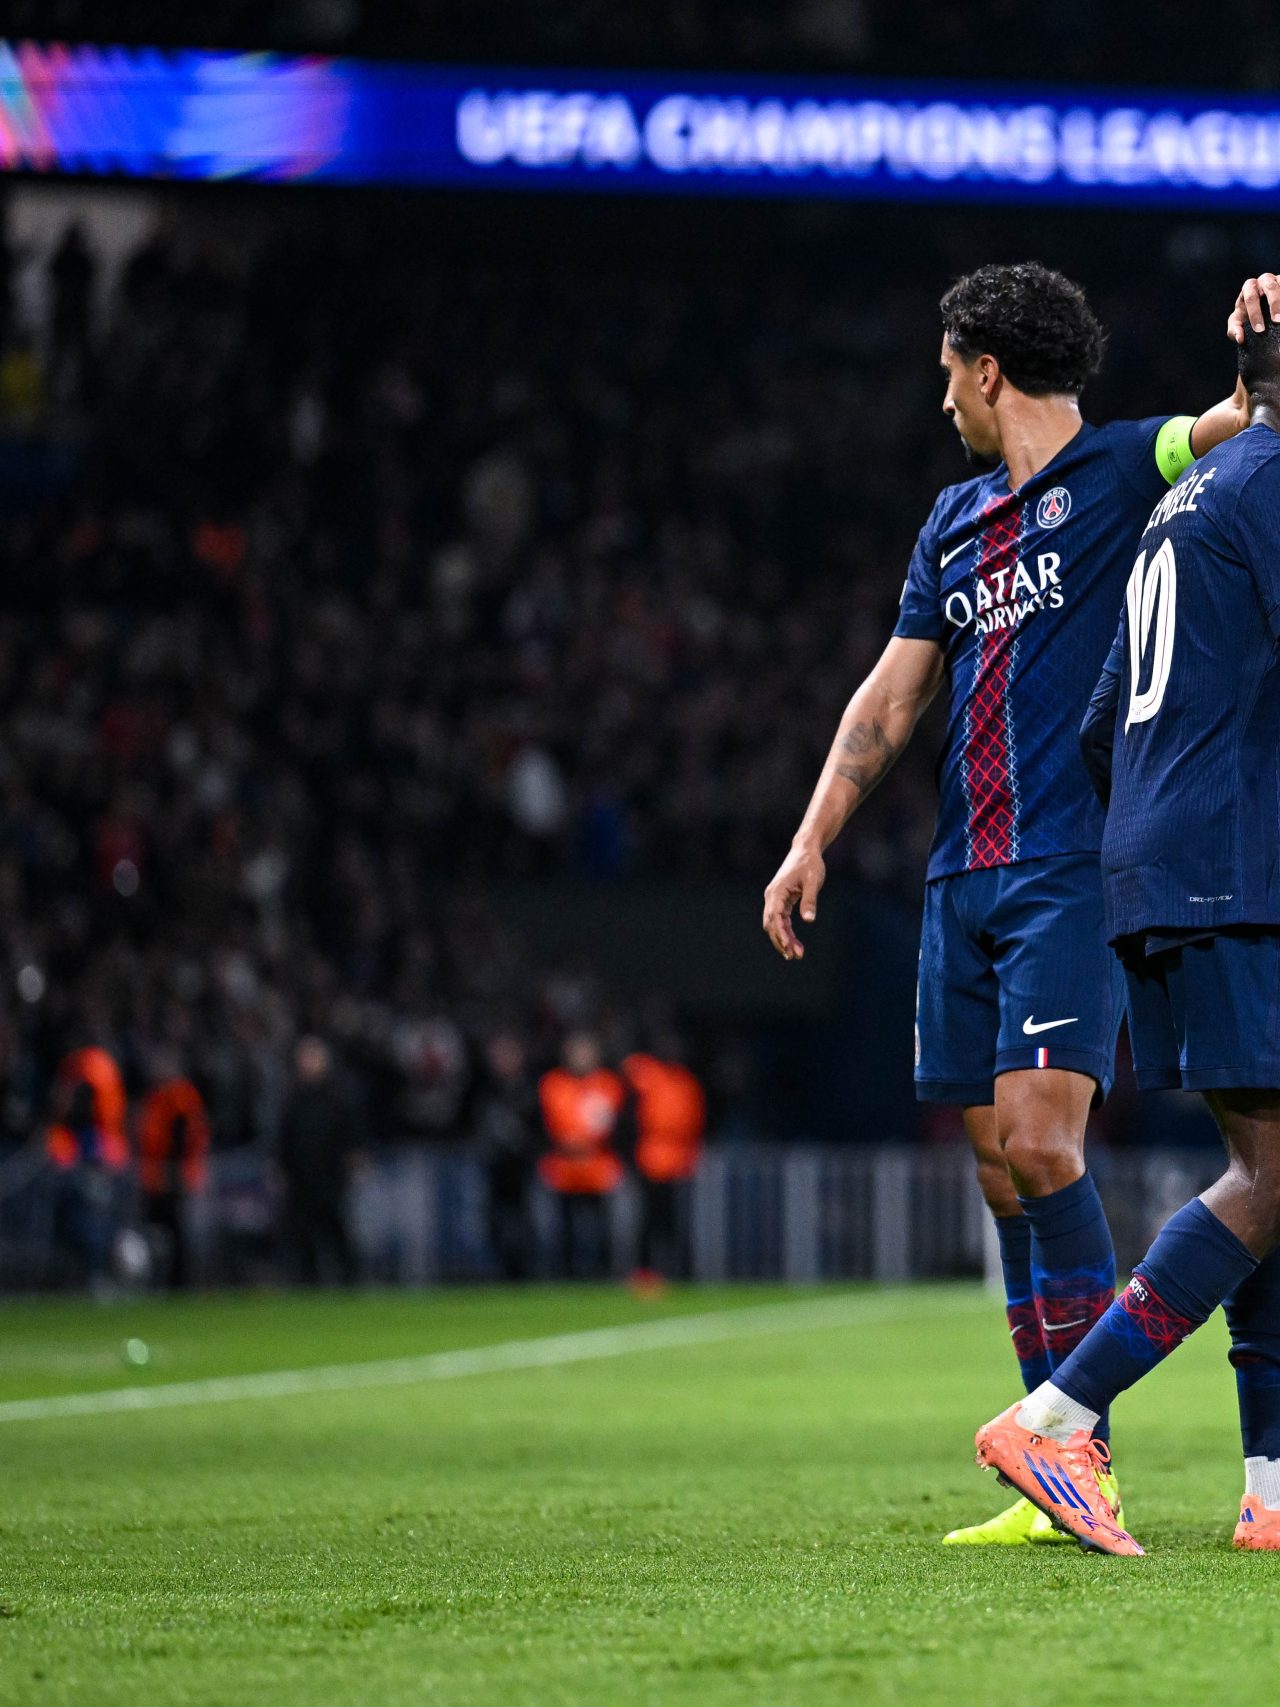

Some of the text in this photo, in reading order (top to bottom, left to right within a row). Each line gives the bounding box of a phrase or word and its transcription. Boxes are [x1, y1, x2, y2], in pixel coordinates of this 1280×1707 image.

[457, 88, 640, 171] UEFA
[644, 93, 1057, 183] CHAMPIONS
[1141, 467, 1217, 539] EMBÉLÉ
[945, 552, 1062, 628] QATAR
[975, 586, 1064, 636] AIRWAYS
[1125, 537, 1177, 738] 10
